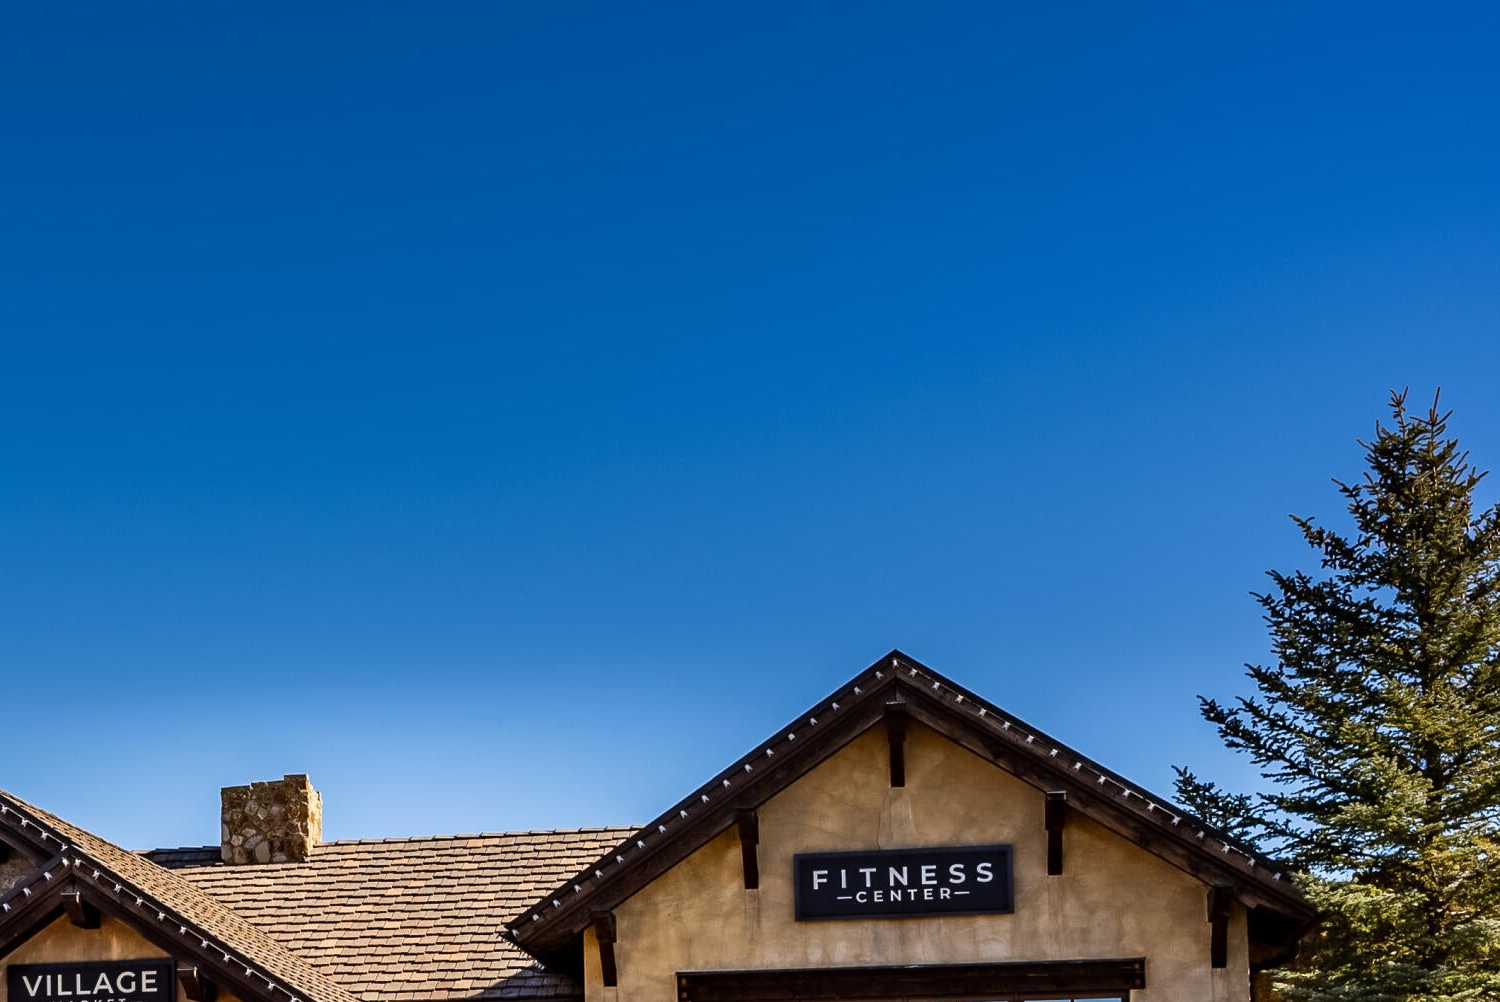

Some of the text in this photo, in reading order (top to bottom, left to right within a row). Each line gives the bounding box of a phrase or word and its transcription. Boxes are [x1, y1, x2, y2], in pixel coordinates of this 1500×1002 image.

[812, 862, 994, 890] FITNESS
[855, 887, 951, 903] CENTER
[22, 970, 158, 997] VILLAGE
